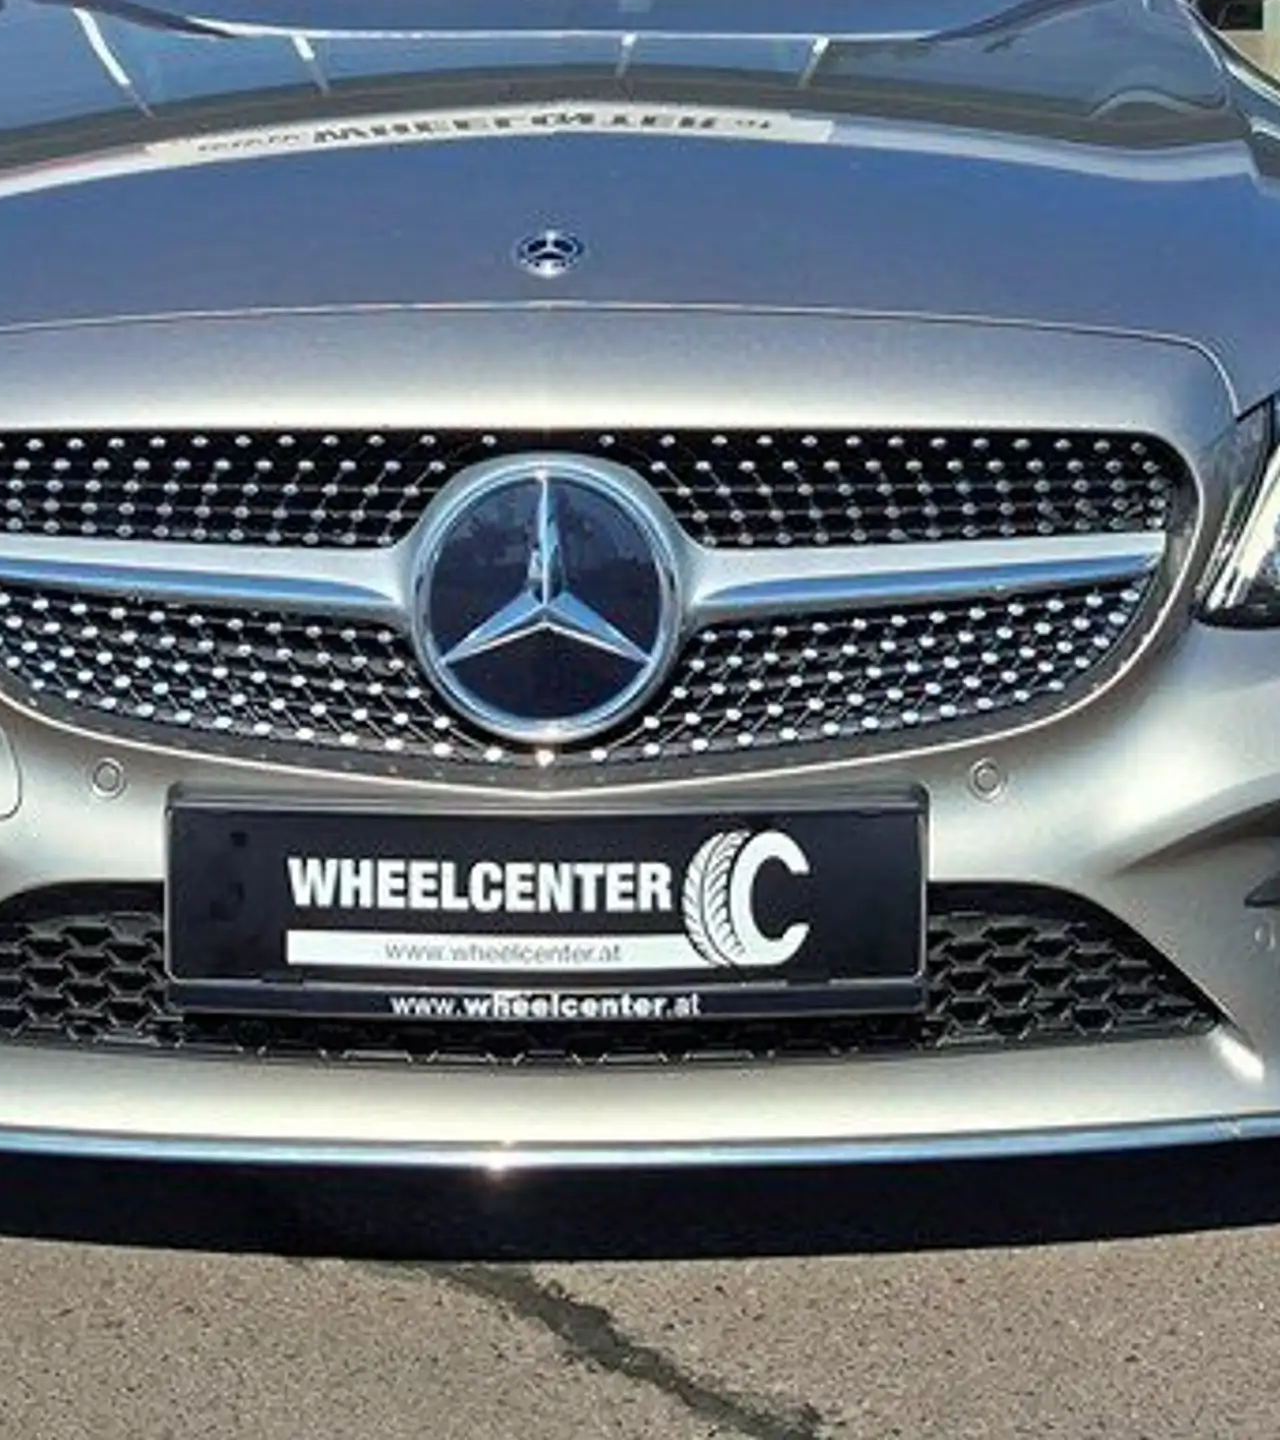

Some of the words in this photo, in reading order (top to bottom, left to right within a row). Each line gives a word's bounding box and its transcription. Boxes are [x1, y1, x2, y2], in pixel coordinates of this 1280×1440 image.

[287, 858, 673, 912] WHEELCENTER
[385, 940, 624, 964] www.wheelcenter.at
[391, 991, 702, 1018] www.wheelcenter.at
